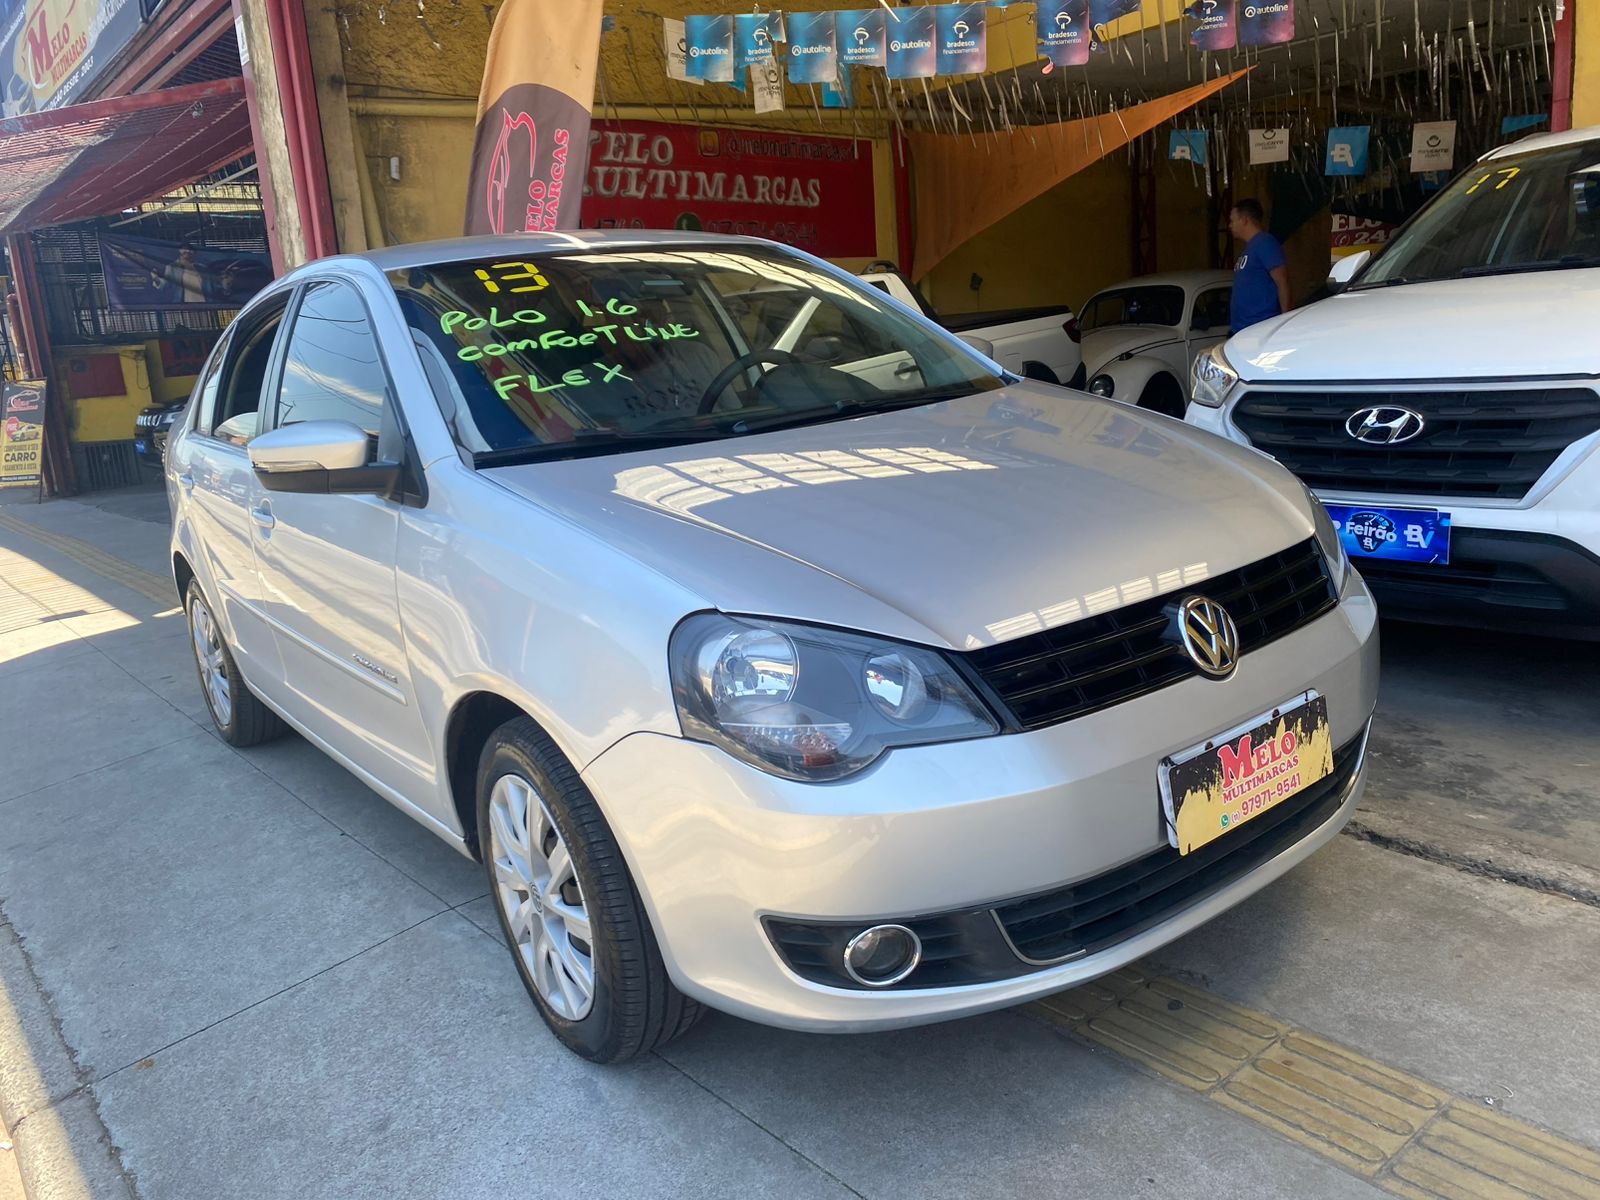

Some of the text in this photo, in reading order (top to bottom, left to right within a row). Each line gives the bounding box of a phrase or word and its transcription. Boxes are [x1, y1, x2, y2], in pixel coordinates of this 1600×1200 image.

[1257, 3, 1289, 14] autoline
[27, 10, 70, 85] MELO
[901, 40, 931, 49] autoline
[946, 40, 975, 48] bradesco
[1048, 31, 1078, 39] bradesco
[700, 46, 729, 56] autoline
[802, 45, 832, 54] autoline
[583, 166, 821, 208] ULTIMARCAS
[1466, 167, 1520, 195] 17
[474, 262, 550, 293] 13
[440, 298, 638, 335] POLO 1.6
[494, 362, 634, 400] FLEX
[4, 451, 37, 463] CARRO
[1345, 521, 1397, 542] Feirão
[1217, 731, 1297, 789] MELO
[1223, 755, 1299, 804] MULTIMARCAS
[1241, 773, 1301, 817] 97971-9541
